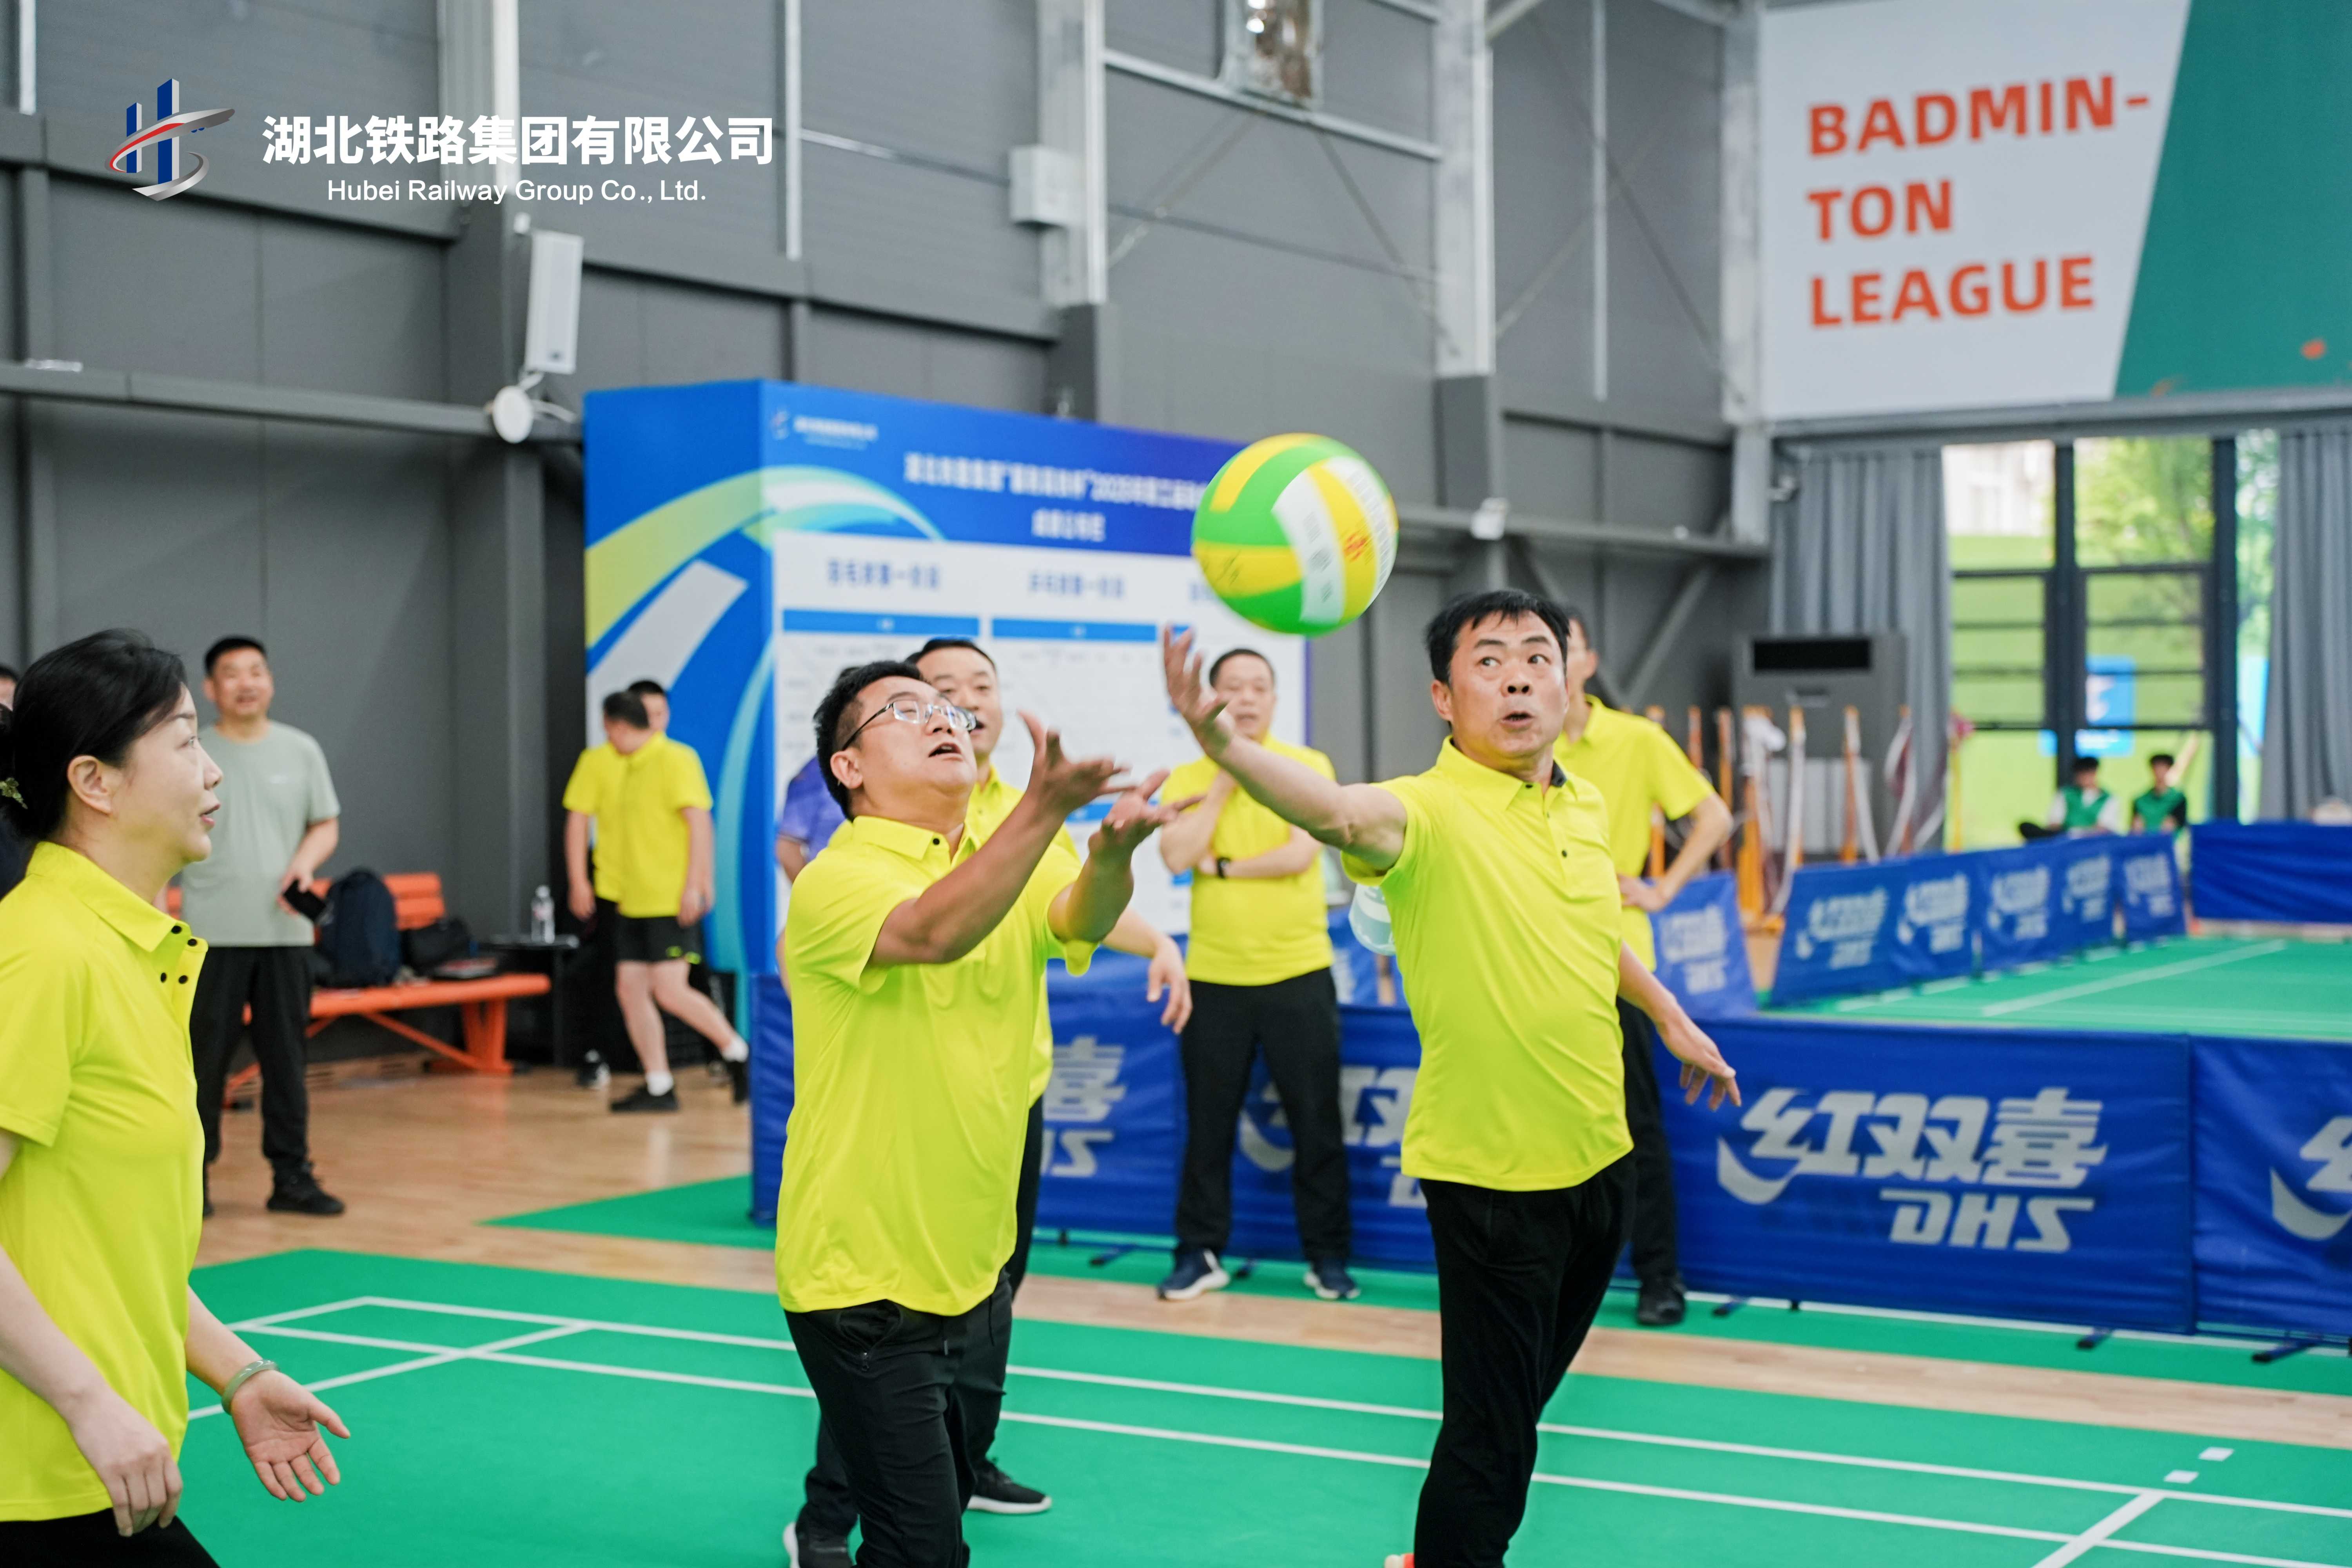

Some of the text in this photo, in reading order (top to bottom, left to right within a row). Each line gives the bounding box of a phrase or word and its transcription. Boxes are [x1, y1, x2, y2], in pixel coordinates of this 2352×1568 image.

[1809, 74, 2149, 156] BADMIN-
[1807, 180, 1952, 241] TON
[1811, 256, 2094, 327] LEAGUE
[1717, 1087, 2107, 1203] 红双喜
[1880, 1189, 2094, 1252] DHS
